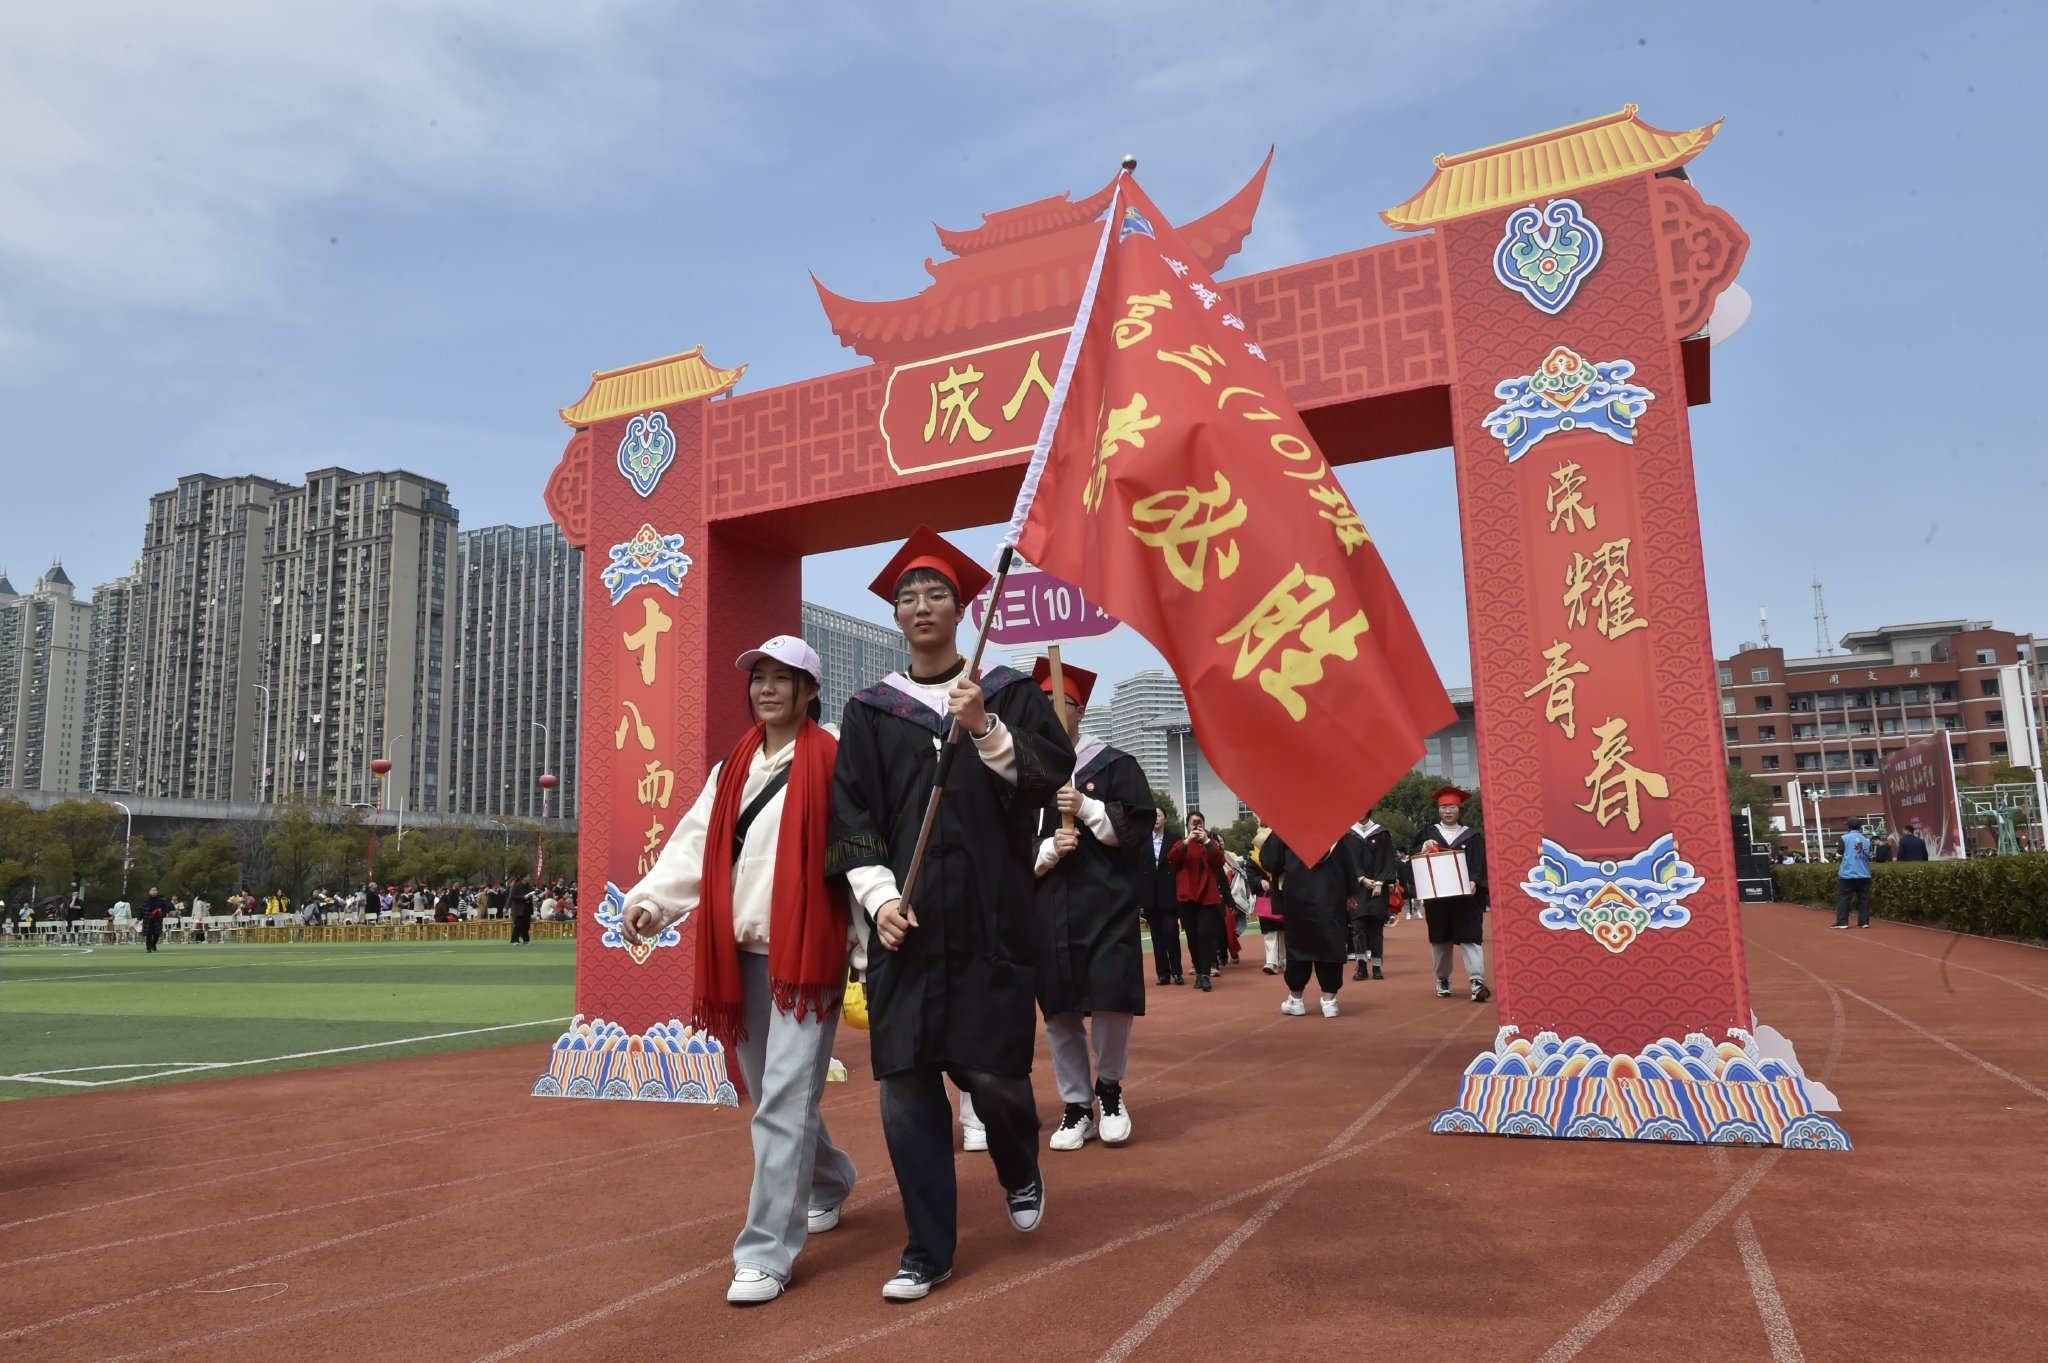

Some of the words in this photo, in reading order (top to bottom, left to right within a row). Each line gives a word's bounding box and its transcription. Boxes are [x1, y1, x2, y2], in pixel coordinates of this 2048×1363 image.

[923, 350, 1055, 445] 成人
[977, 585, 1109, 631] 高三(10)
[1524, 459, 1670, 832] 荣耀青春
[615, 598, 674, 875] 十八而志
